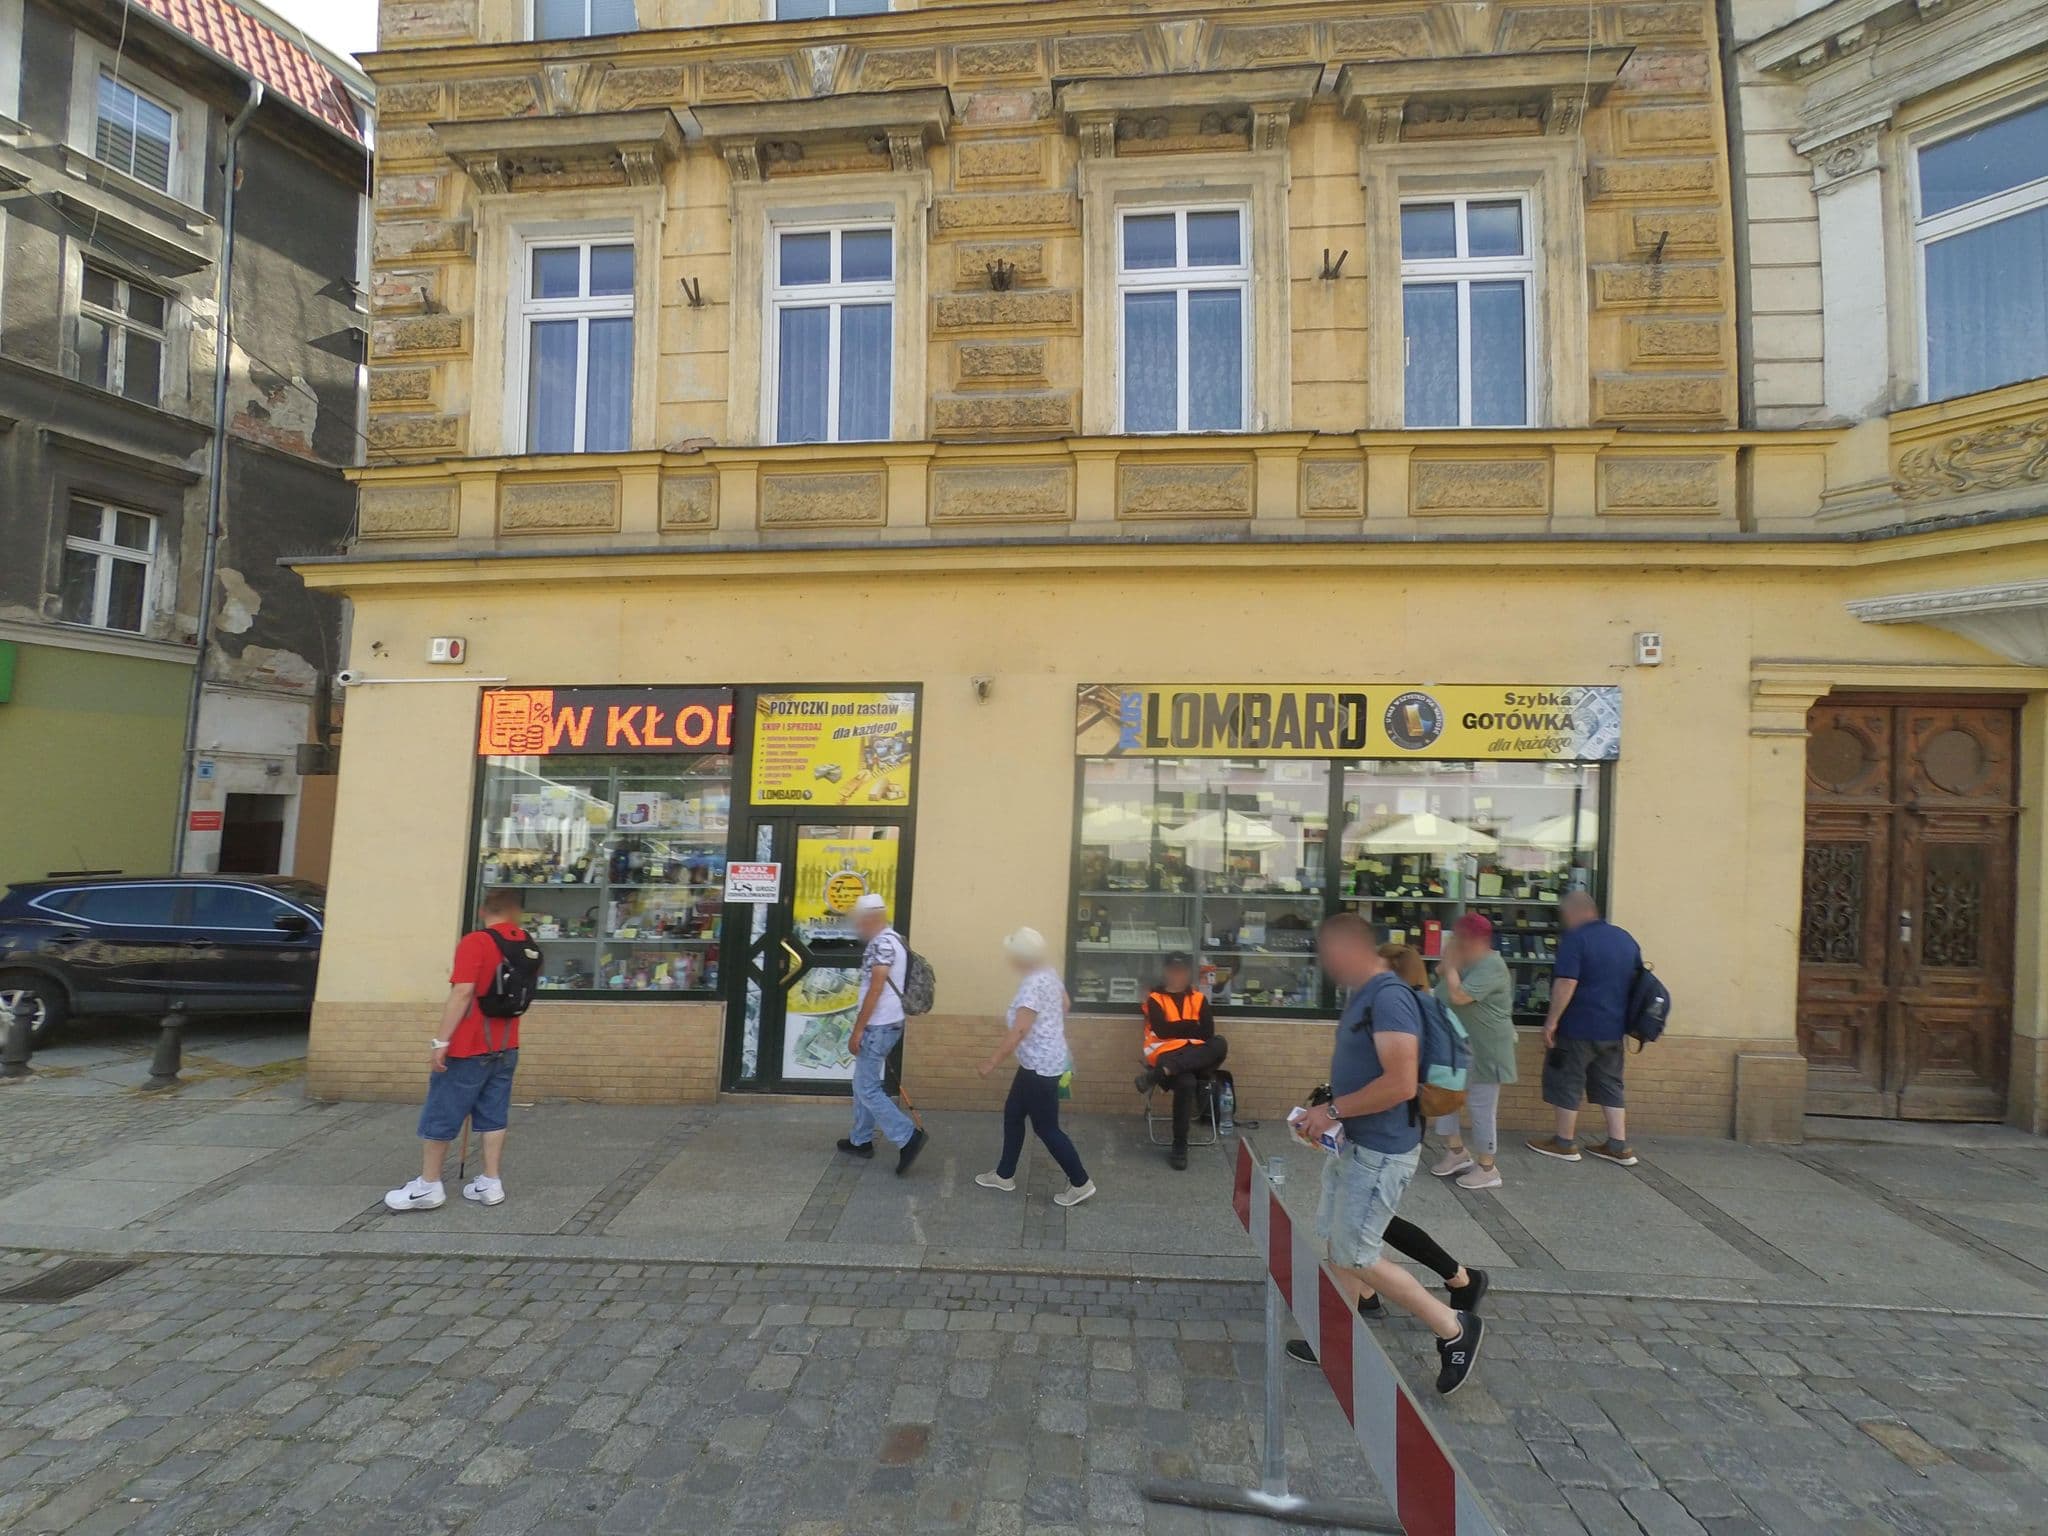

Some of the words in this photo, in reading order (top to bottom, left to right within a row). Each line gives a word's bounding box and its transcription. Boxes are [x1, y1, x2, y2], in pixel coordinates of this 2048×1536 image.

[1504, 692, 1571, 708] Szybka
[831, 702, 855, 717] pod
[857, 703, 899, 716] zastaw
[1147, 692, 1367, 750] LOMBARD
[1462, 709, 1576, 731] GOTÓWKA
[832, 726, 851, 740] dla
[1488, 738, 1512, 752] dla
[738, 866, 768, 874] ZAKAZ
